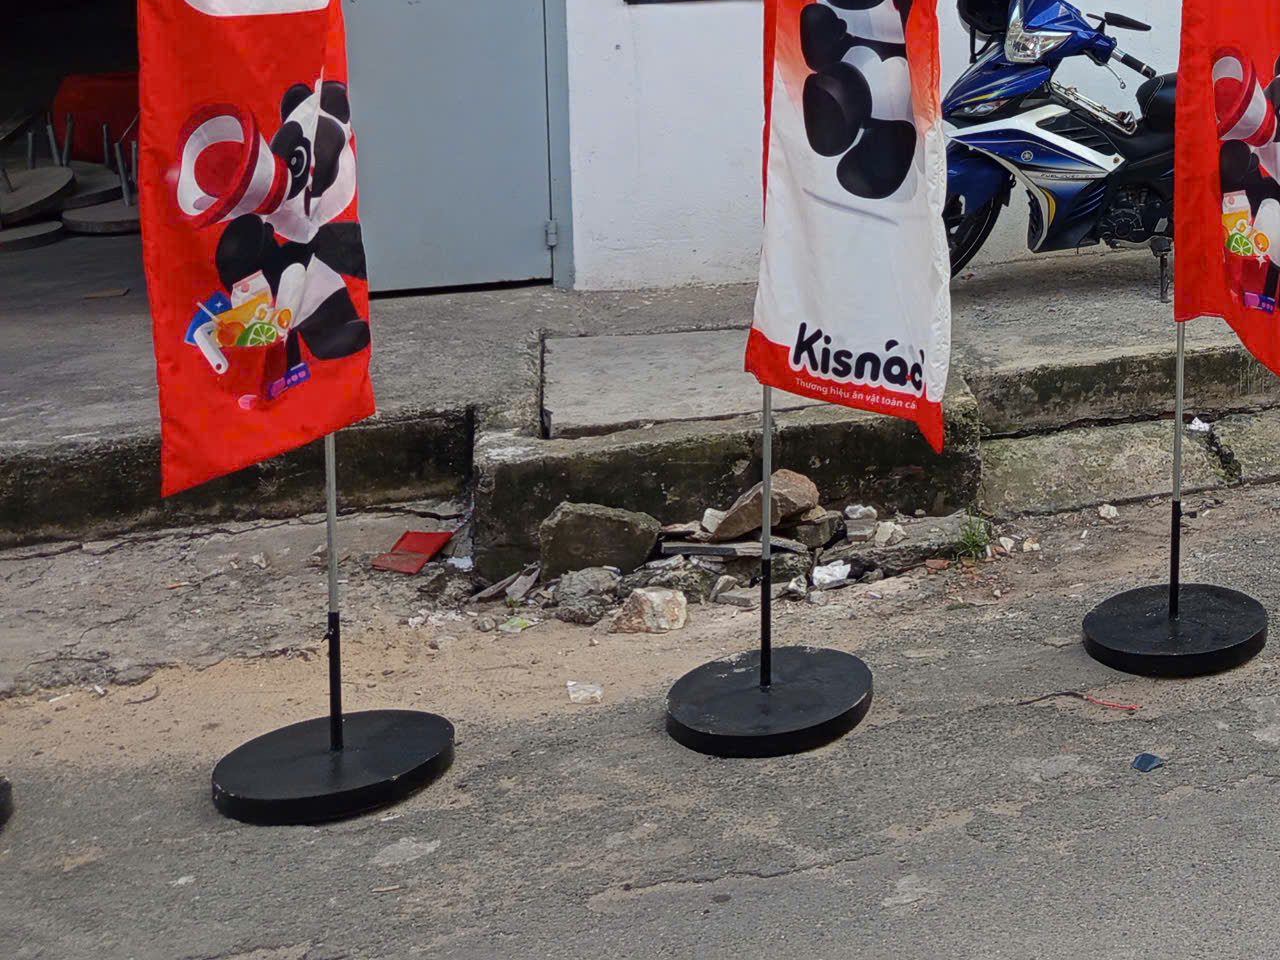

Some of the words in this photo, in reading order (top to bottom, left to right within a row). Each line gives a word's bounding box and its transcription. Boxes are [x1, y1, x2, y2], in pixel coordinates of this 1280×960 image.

[795, 377, 828, 395] Thương
[830, 387, 850, 398] hiệu
[866, 393, 880, 405] vặt
[882, 397, 903, 407] toàn
